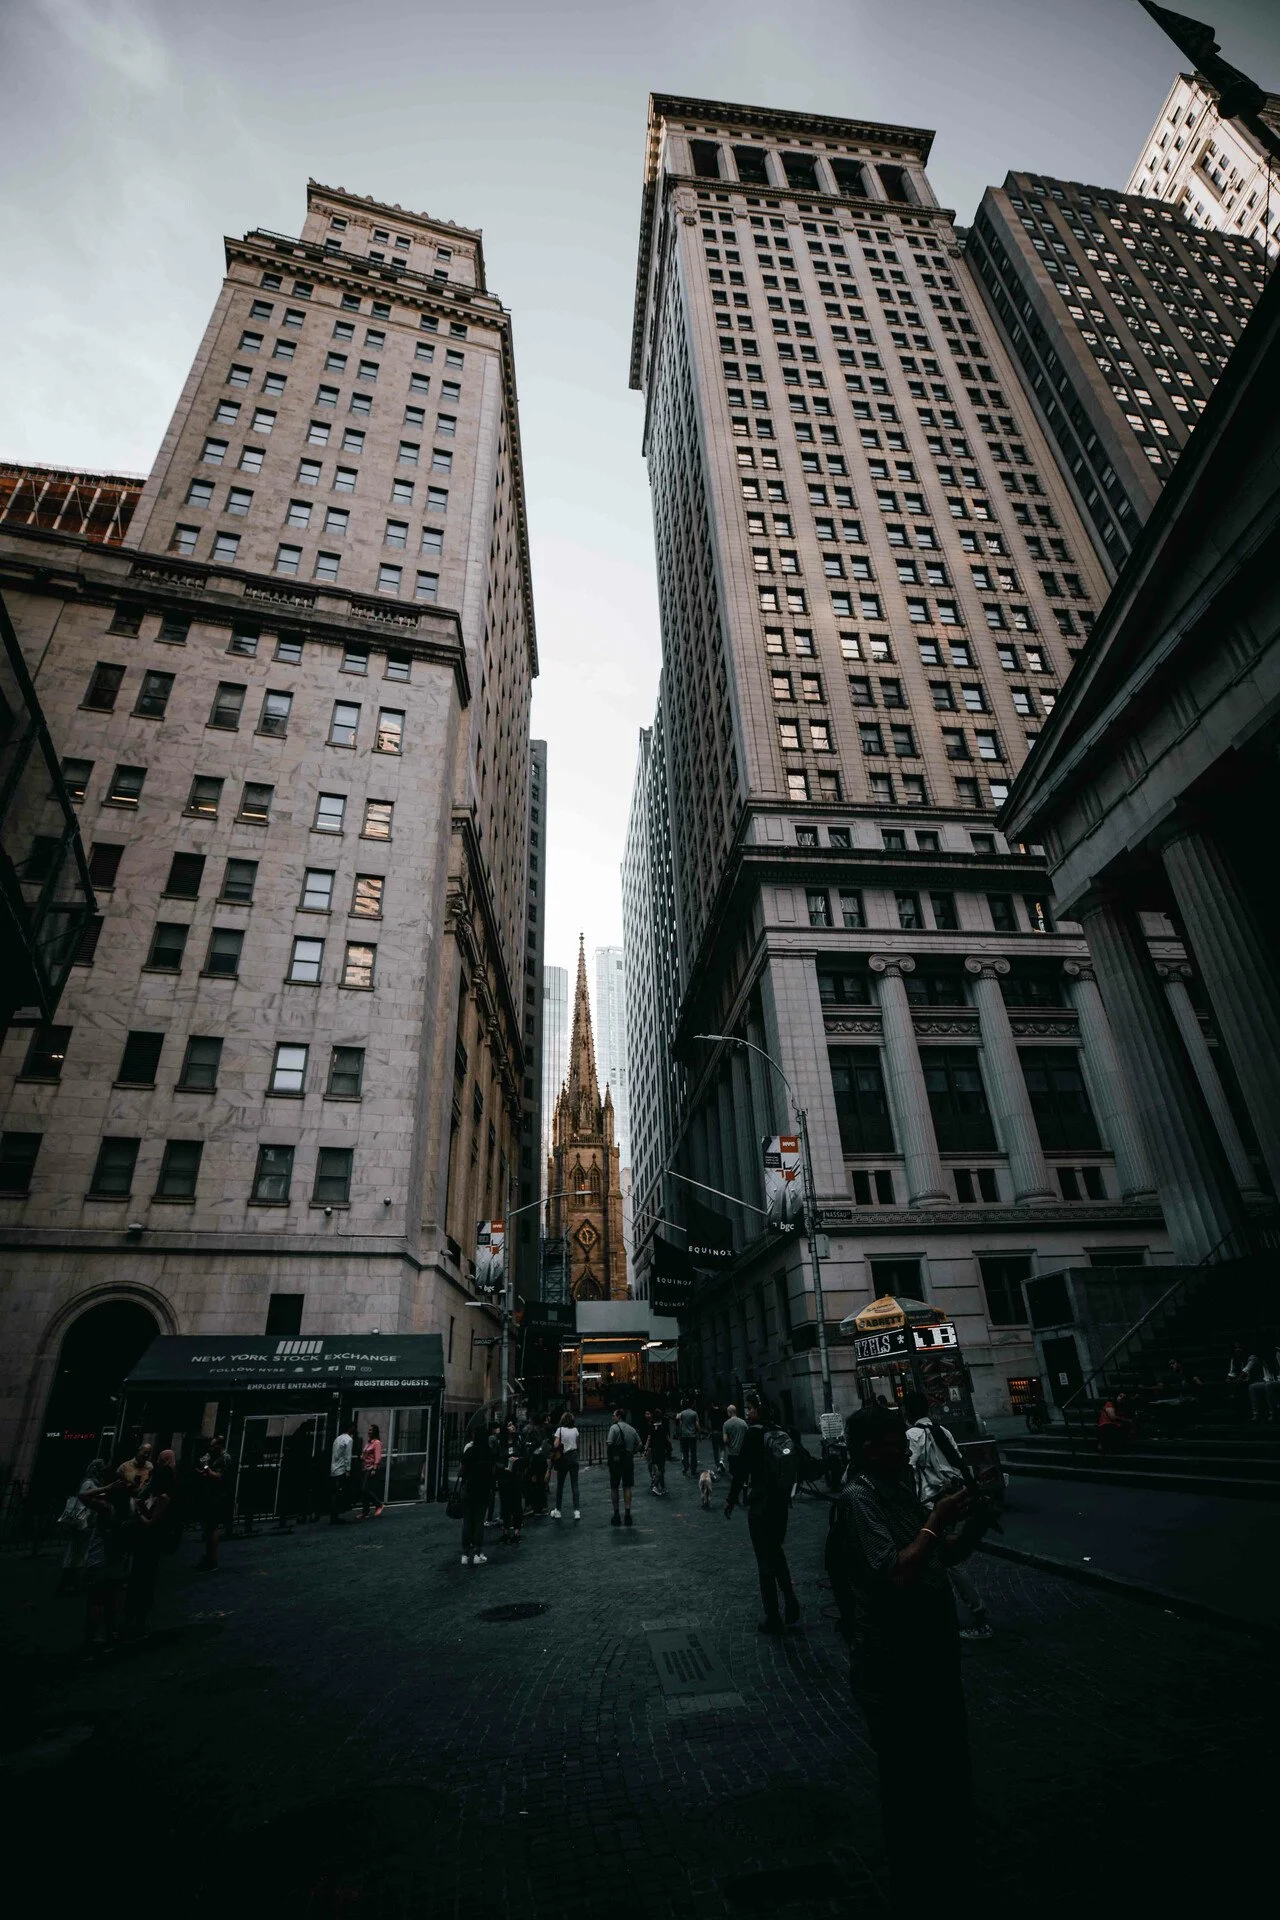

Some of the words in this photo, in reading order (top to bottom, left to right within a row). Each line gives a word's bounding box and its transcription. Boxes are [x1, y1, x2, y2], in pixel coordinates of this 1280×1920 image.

[780, 1221, 795, 1233] bgc
[688, 1245, 732, 1256] EQUINOX
[860, 1315, 902, 1329] SABRETT
[230, 1353, 268, 1361] YORK
[324, 1352, 397, 1362] EXCHANGE
[247, 1383, 286, 1391] EMPLOYEE
